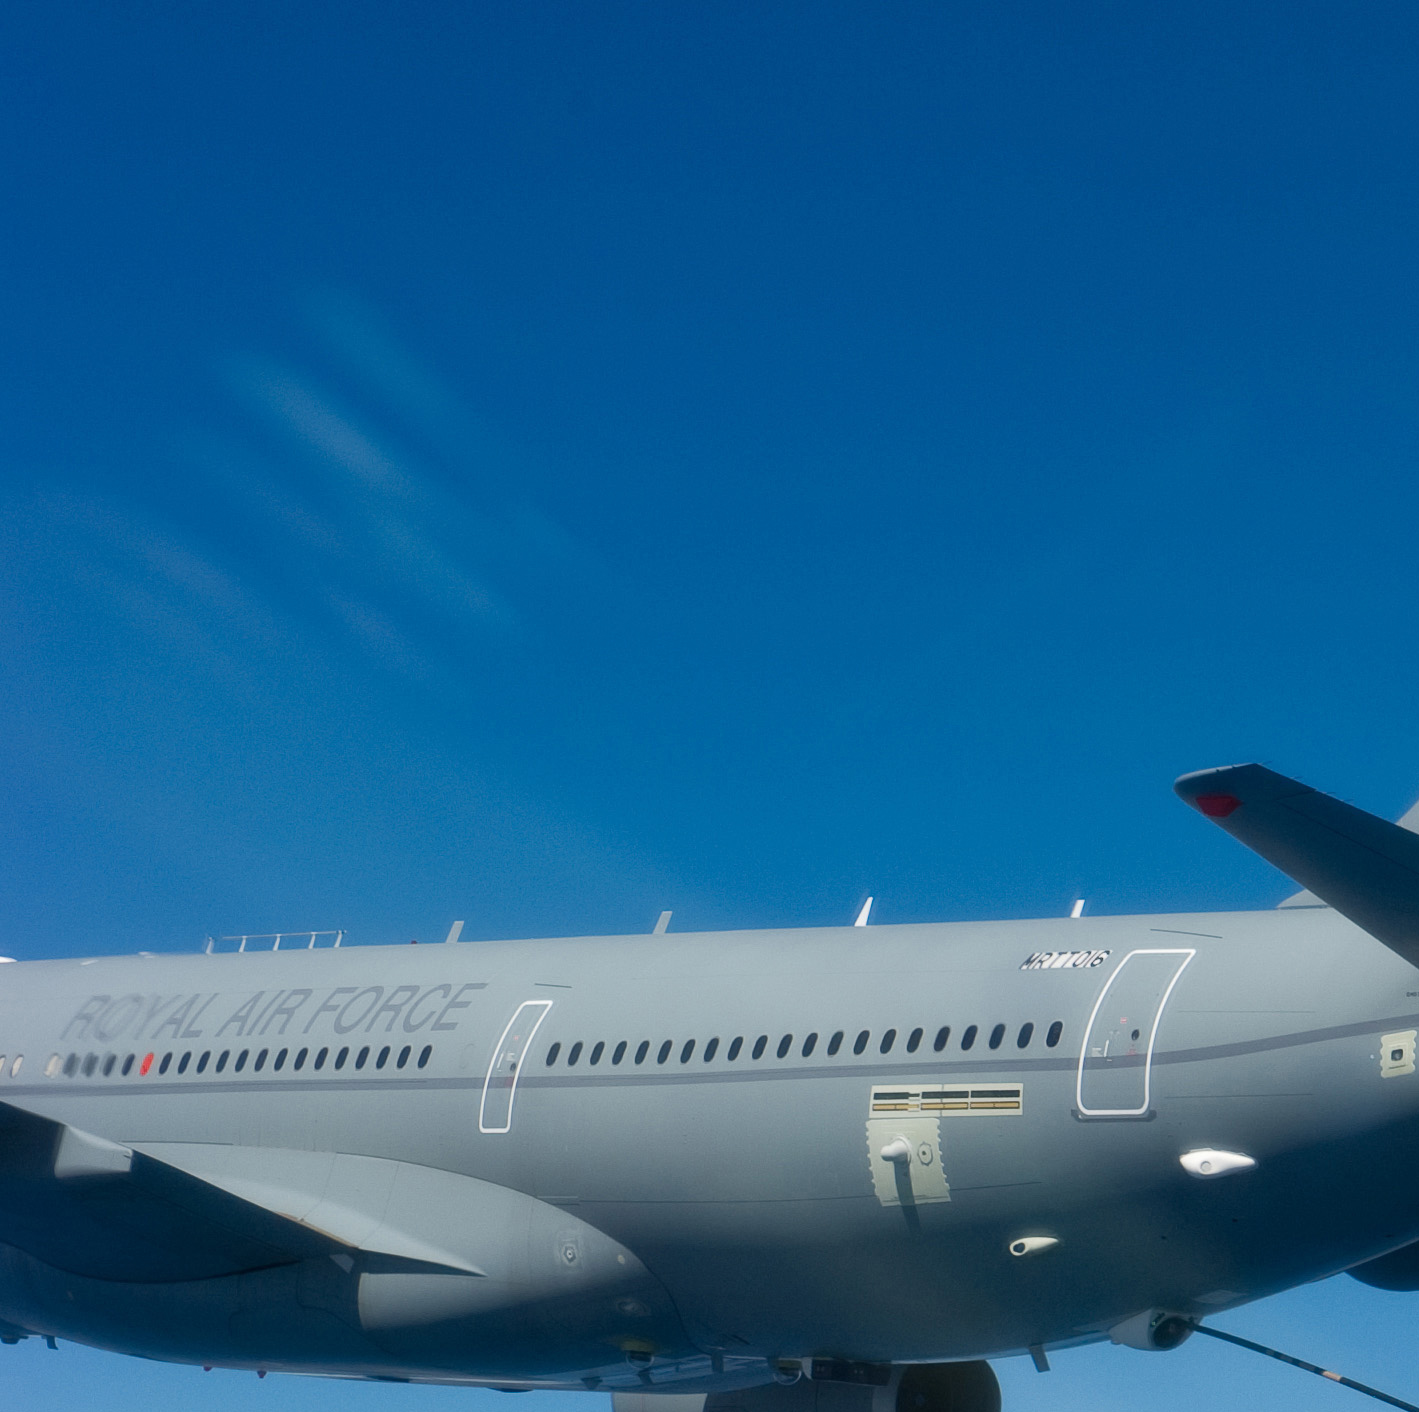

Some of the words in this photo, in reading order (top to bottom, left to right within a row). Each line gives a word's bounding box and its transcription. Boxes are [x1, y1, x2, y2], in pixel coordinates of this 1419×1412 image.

[1018, 950, 1112, 970] MRTT016
[59, 993, 219, 1042] ROYAL
[214, 988, 313, 1039] AIR
[302, 982, 489, 1035] FORCE
